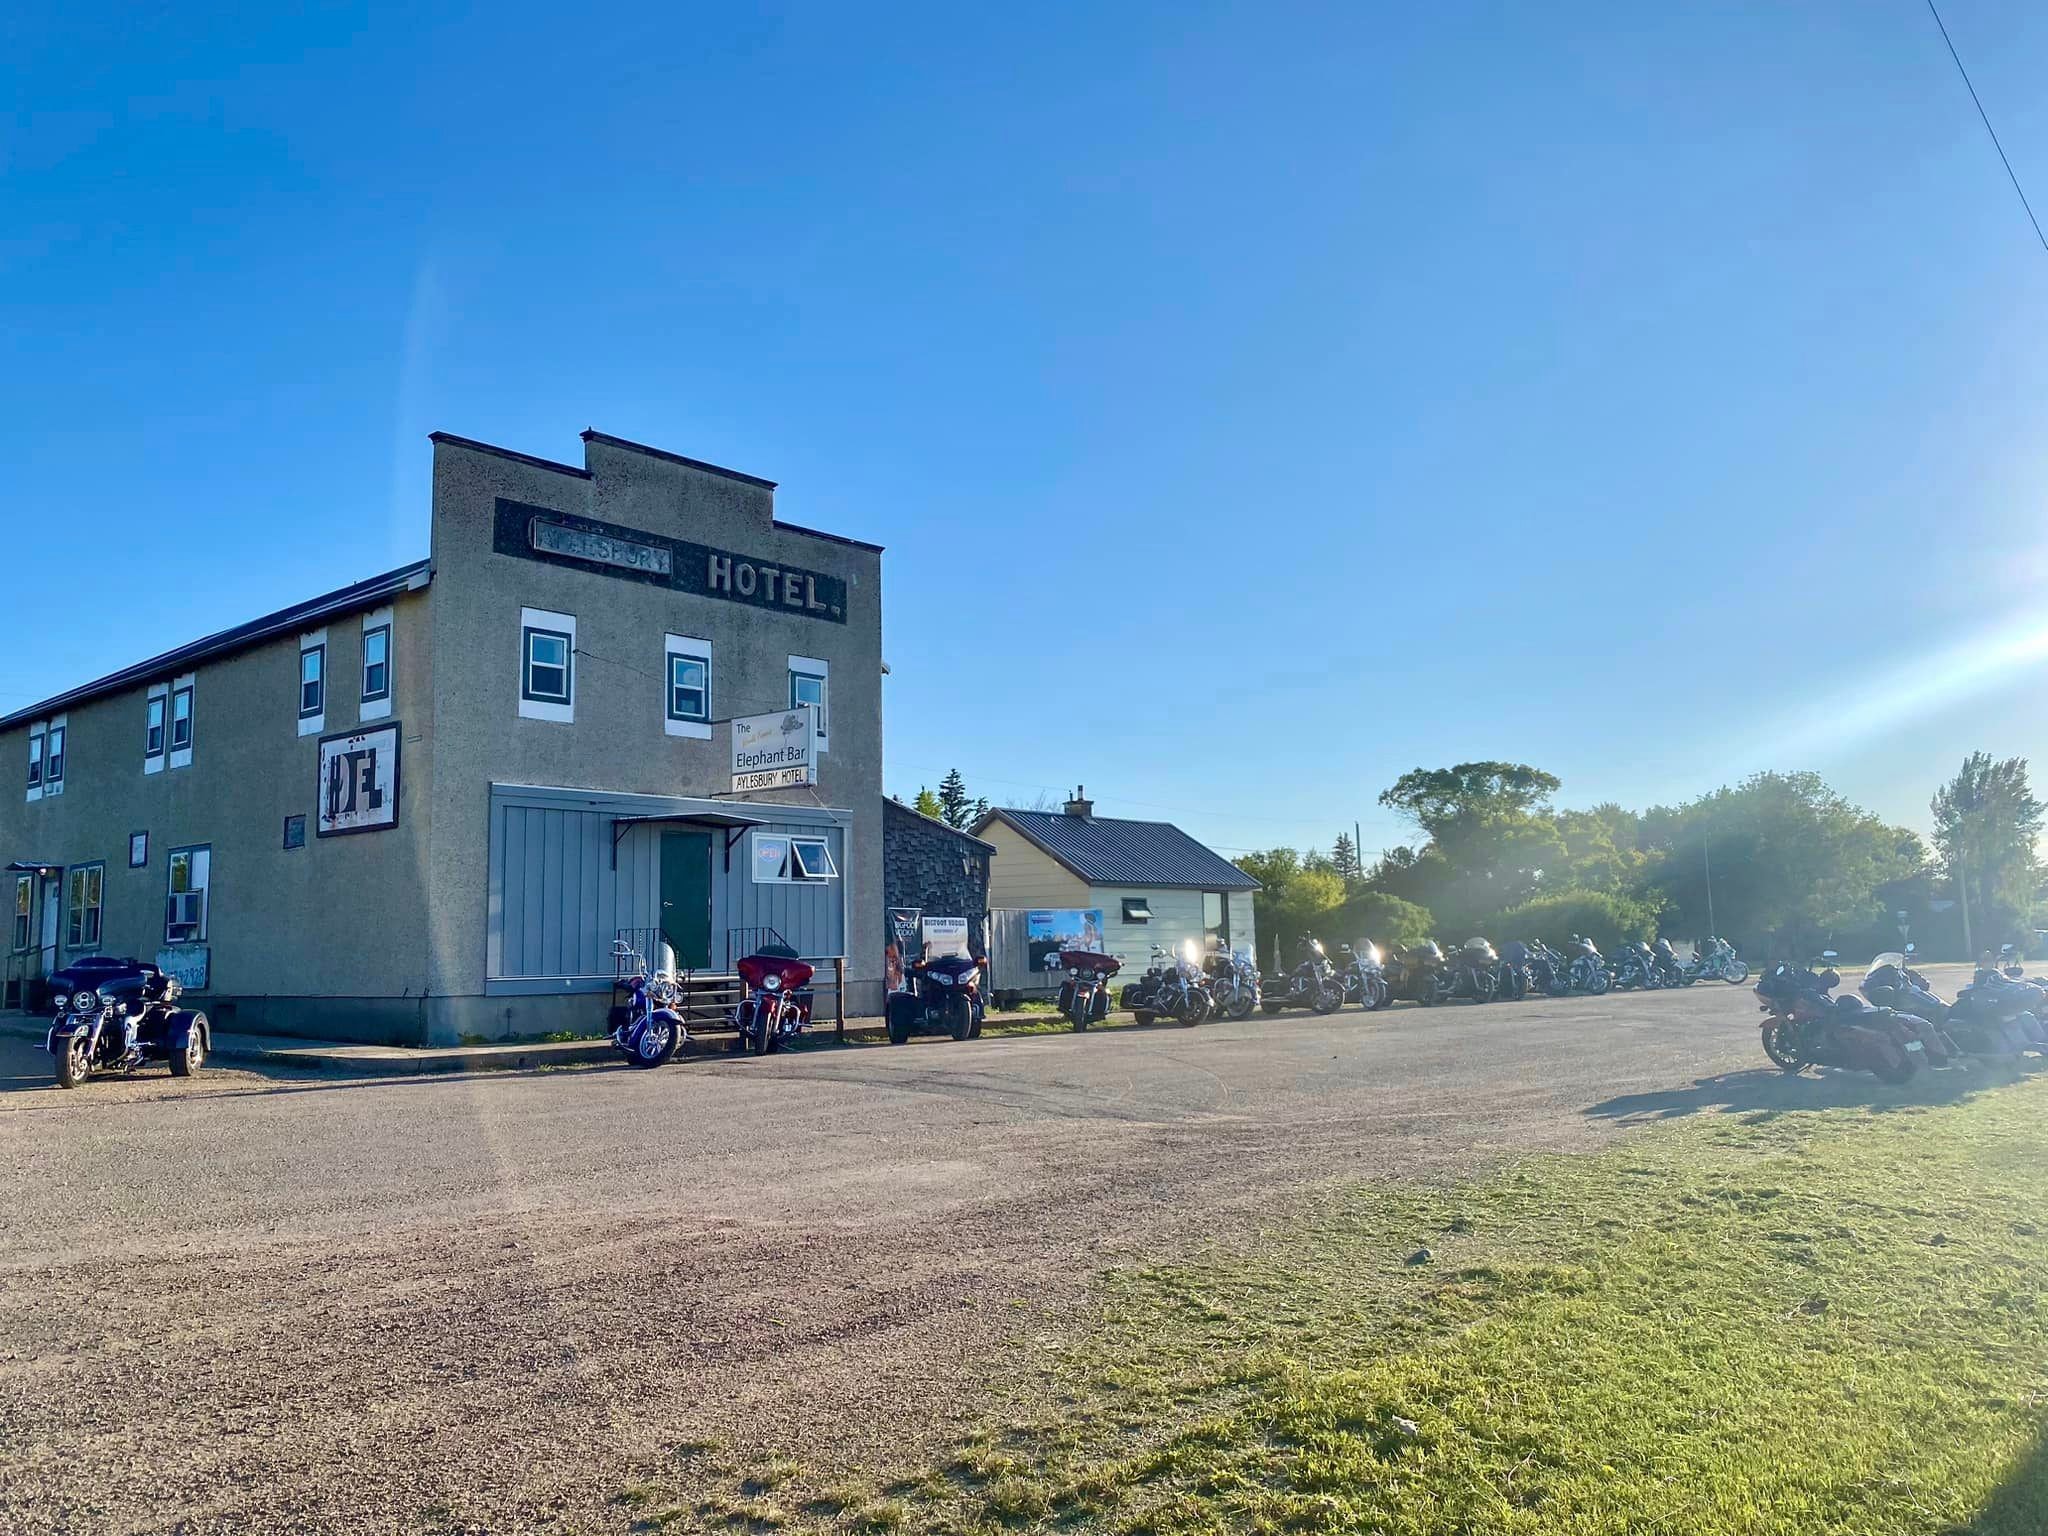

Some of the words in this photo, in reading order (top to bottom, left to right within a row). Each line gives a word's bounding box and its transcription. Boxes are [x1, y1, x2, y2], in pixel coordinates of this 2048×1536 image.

[736, 723, 751, 734] The
[736, 749, 784, 768] Elephant
[787, 746, 805, 761] Bar
[736, 772, 777, 789] AYLESBURY
[781, 769, 803, 784] HOTEL
